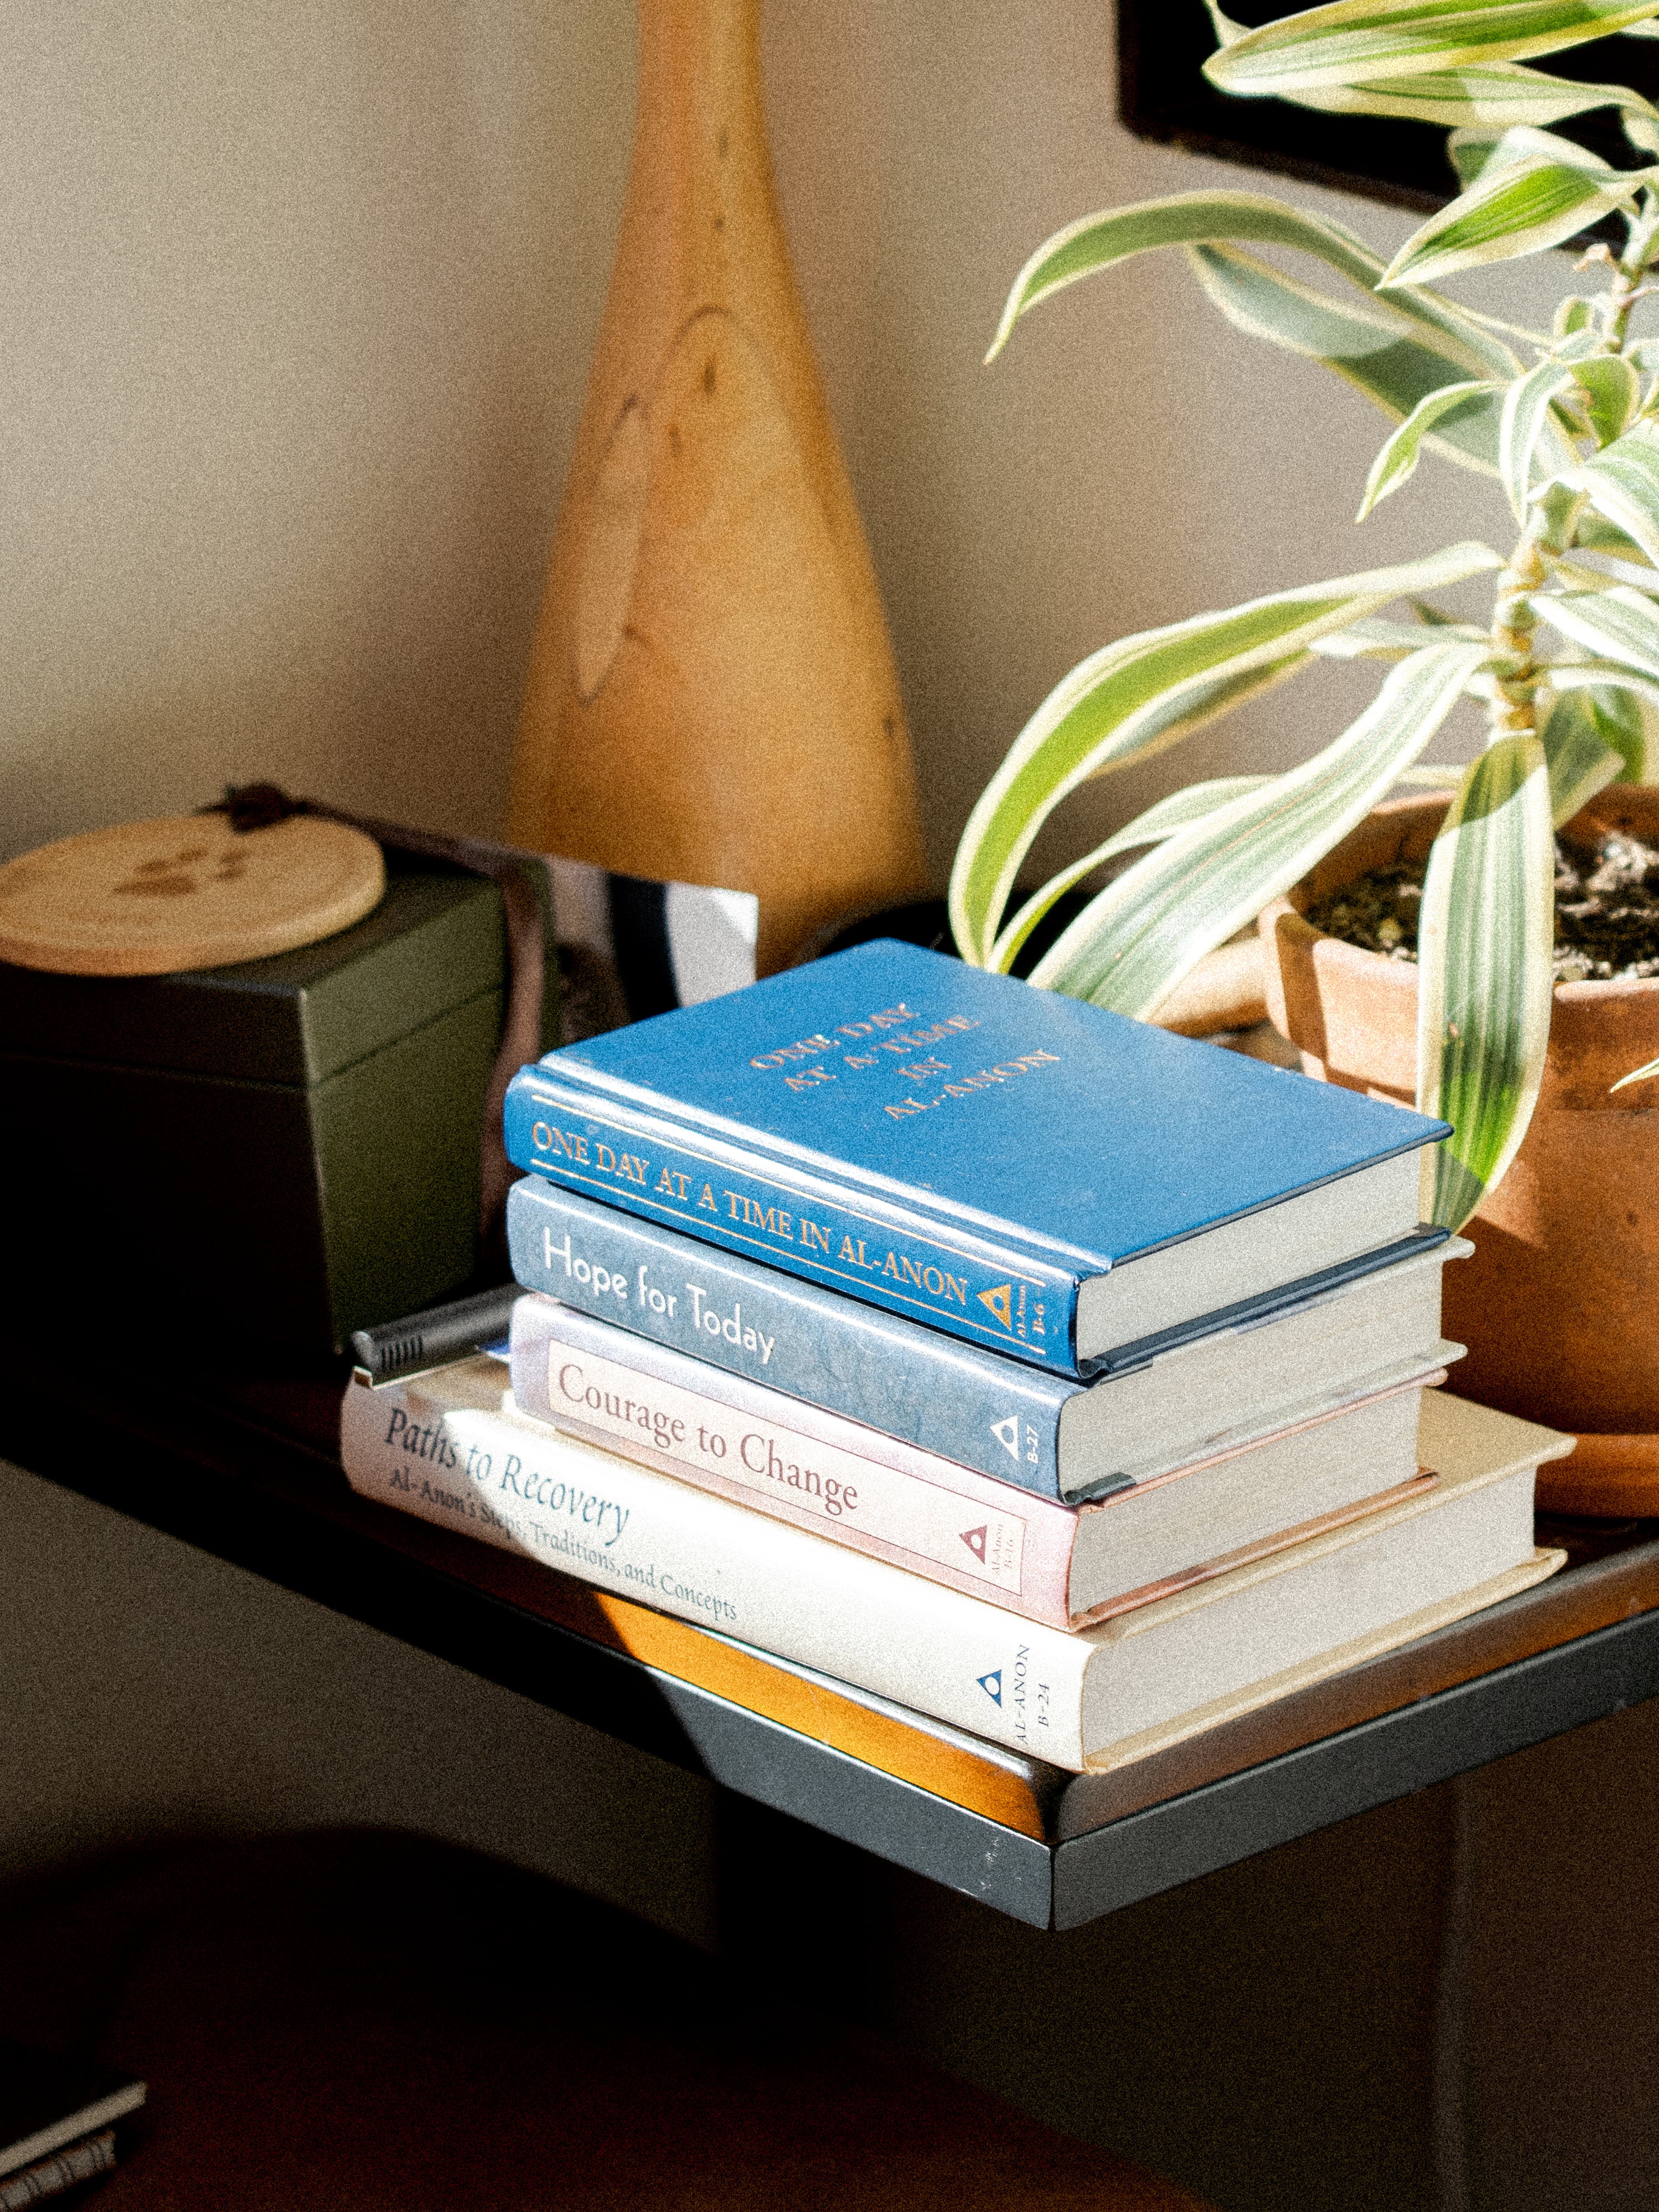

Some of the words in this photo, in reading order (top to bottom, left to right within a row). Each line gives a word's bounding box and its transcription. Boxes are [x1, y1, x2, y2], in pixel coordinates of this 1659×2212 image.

[750, 1034, 841, 1070] ONE
[835, 1003, 920, 1039] DAY
[784, 1065, 837, 1092] AT
[843, 1053, 879, 1071] A
[871, 1015, 981, 1055] TIME
[895, 1056, 952, 1081] IN
[884, 1049, 1061, 1120] AL-ANON
[531, 1121, 590, 1165] ONE
[596, 1142, 650, 1186] DAY
[655, 1167, 692, 1200] AT
[698, 1183, 718, 1212] A
[722, 1190, 794, 1240] TIME
[799, 1218, 831, 1254] IN
[837, 1235, 968, 1306] AL-ANON
[544, 1227, 628, 1300] Hope
[638, 1264, 678, 1318] for
[686, 1283, 776, 1365] Today
[1032, 1301, 1045, 1335] B-6
[384, 1407, 458, 1470] Paths
[465, 1442, 492, 1481] to
[498, 1453, 630, 1547] Recovery
[558, 1364, 686, 1449] Courage
[697, 1426, 728, 1459] to
[739, 1433, 859, 1516] Change
[1026, 1424, 1039, 1464] B-27
[389, 1464, 477, 1518] Al-Anon's
[481, 1501, 528, 1541] Steps,
[529, 1520, 620, 1578] Traditions,
[624, 1562, 657, 1589] and
[660, 1573, 738, 1623] Concepts
[1015, 1644, 1031, 1745] AL-ANON
[1037, 1682, 1050, 1728] B-24
